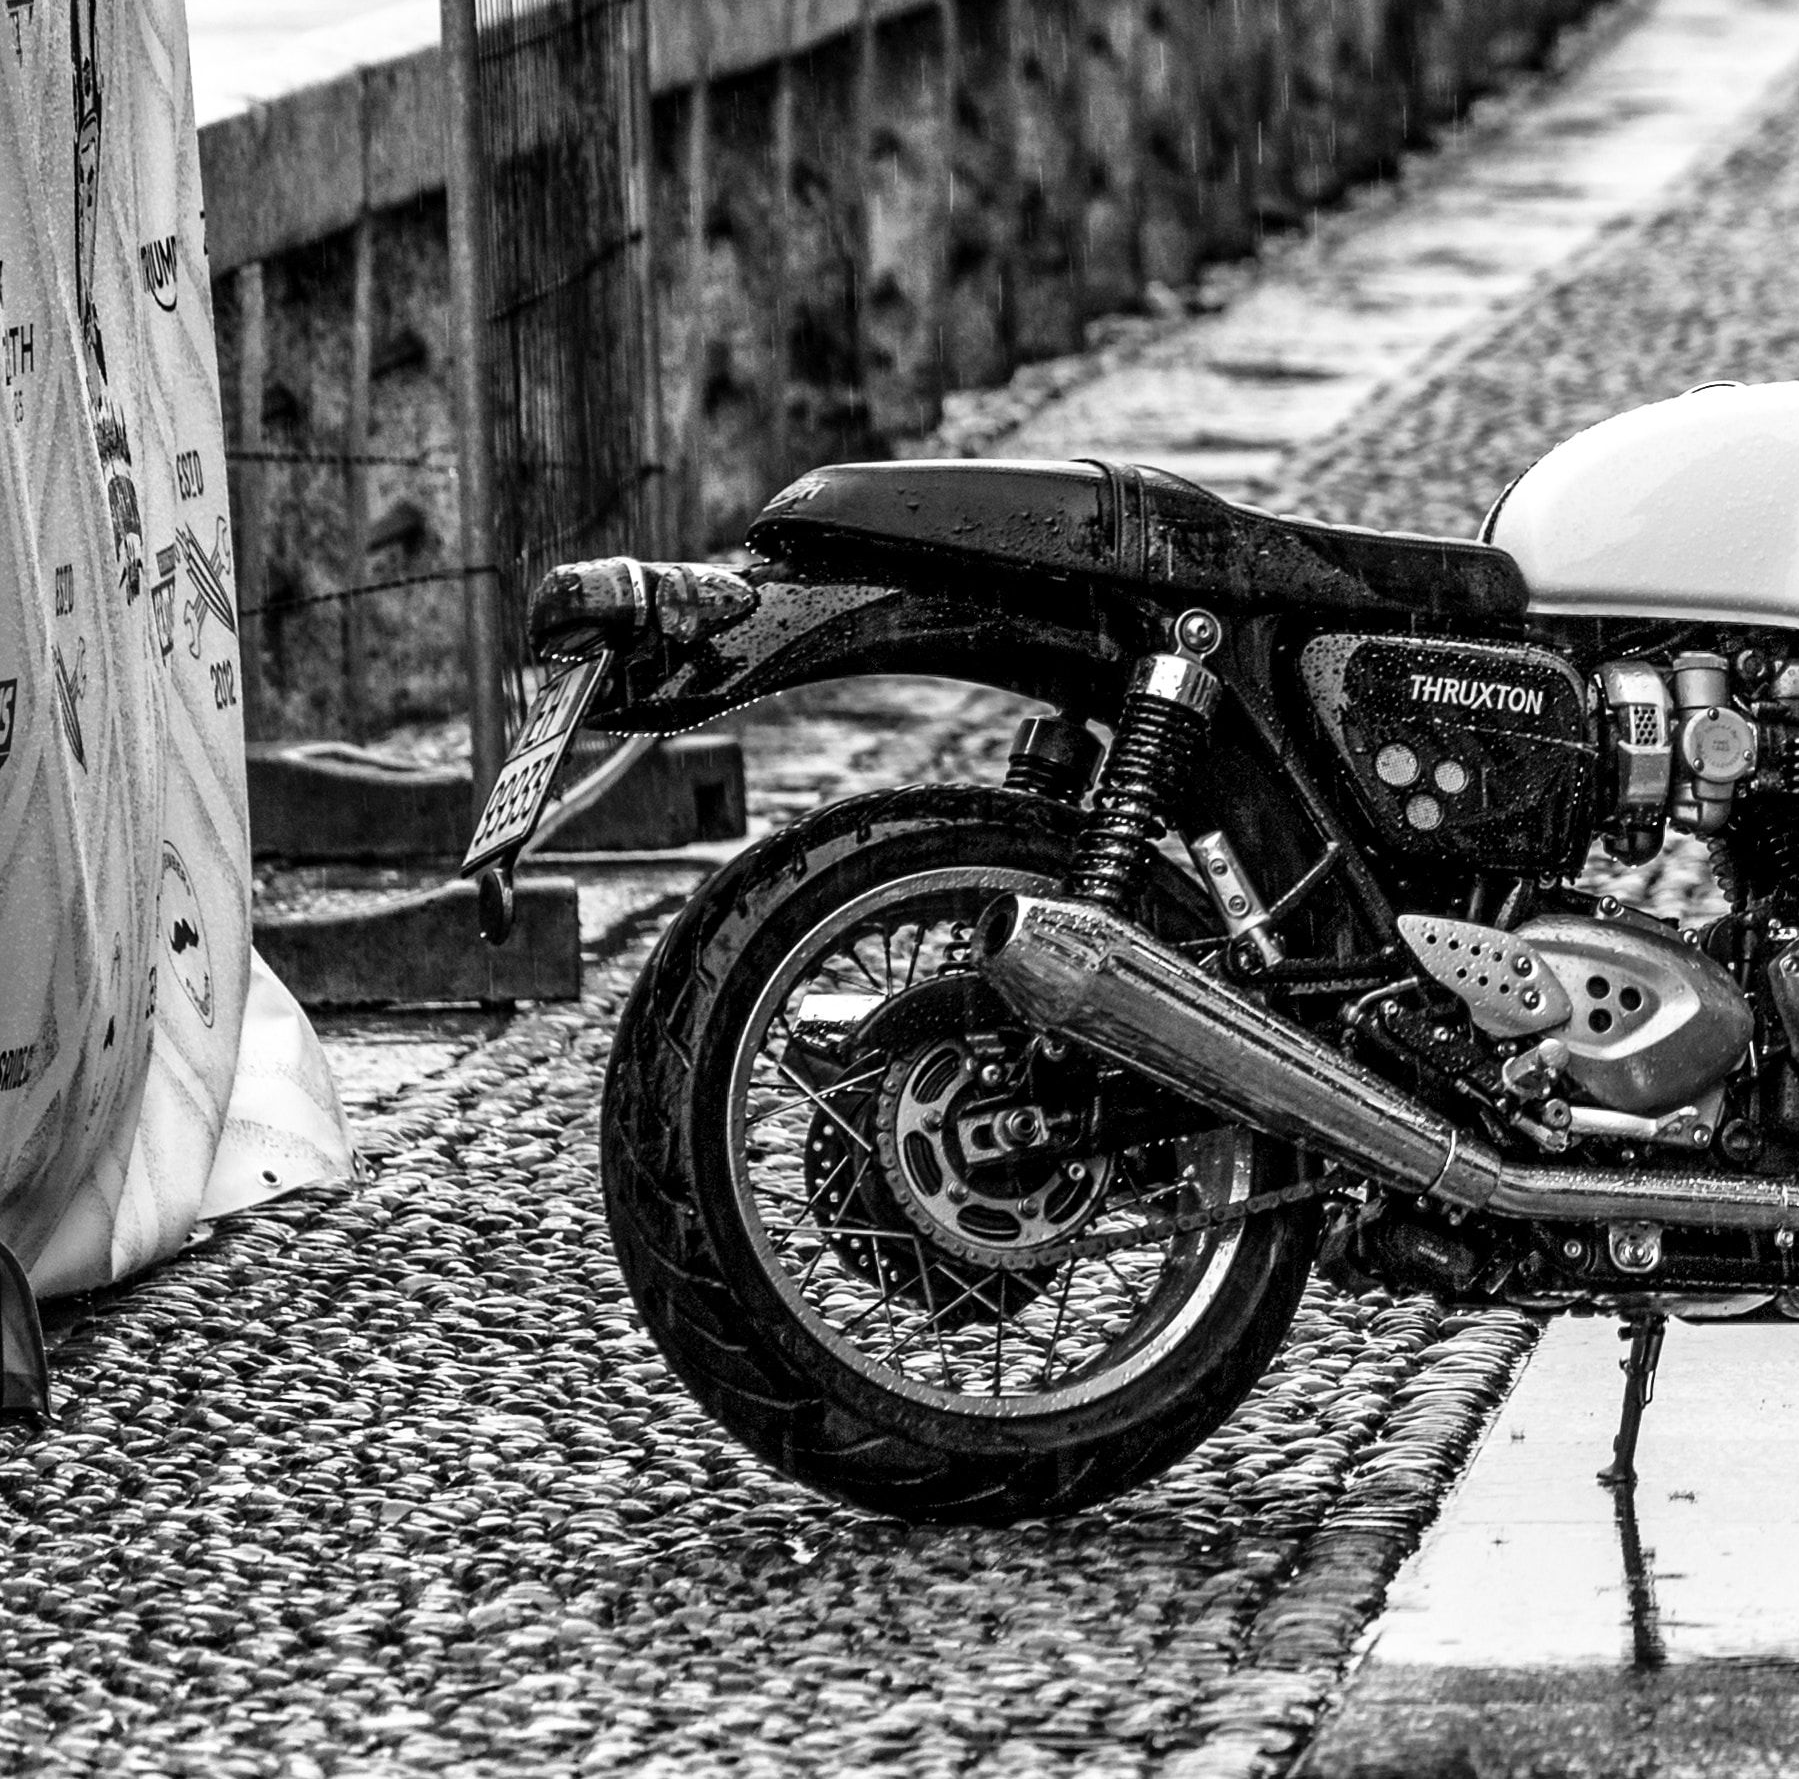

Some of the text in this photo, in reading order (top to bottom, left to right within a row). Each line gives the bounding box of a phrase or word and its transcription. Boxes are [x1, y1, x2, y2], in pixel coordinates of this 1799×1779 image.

[176, 450, 205, 501] ESTD
[210, 660, 237, 710] 2012
[1410, 674, 1544, 715] THRUXTON
